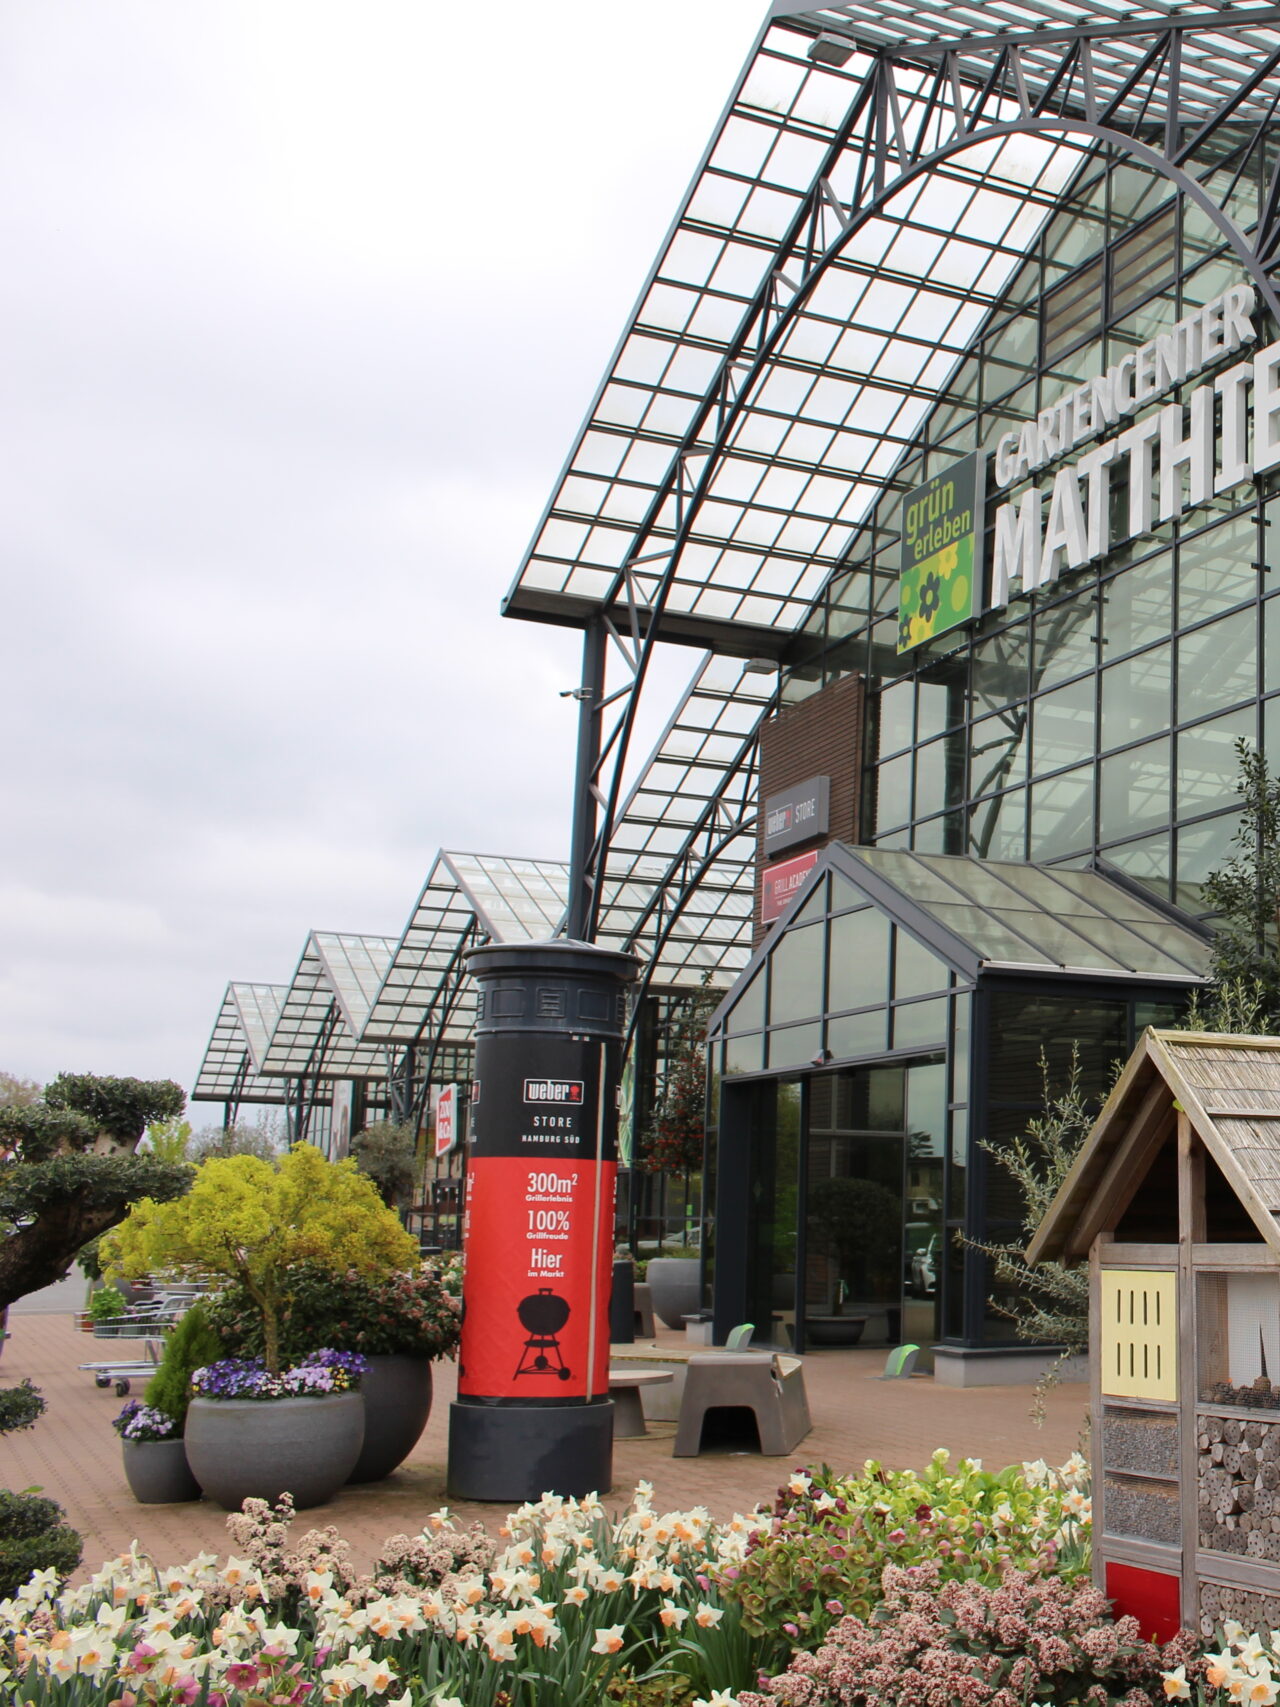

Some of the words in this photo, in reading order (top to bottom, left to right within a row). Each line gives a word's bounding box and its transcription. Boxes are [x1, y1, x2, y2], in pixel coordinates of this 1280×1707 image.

[994, 283, 1258, 488] GARTENCENTER
[906, 478, 955, 545] grün
[914, 510, 971, 560] erleben
[795, 798, 816, 823] STORE
[528, 1080, 569, 1101] weber
[533, 1116, 572, 1128] STORE
[521, 1135, 561, 1143] HAMBURG
[525, 1194, 573, 1202] Grillerlebnis
[527, 1210, 570, 1231] 100%
[526, 1232, 569, 1240] Grillfreude
[530, 1248, 563, 1269] Hier
